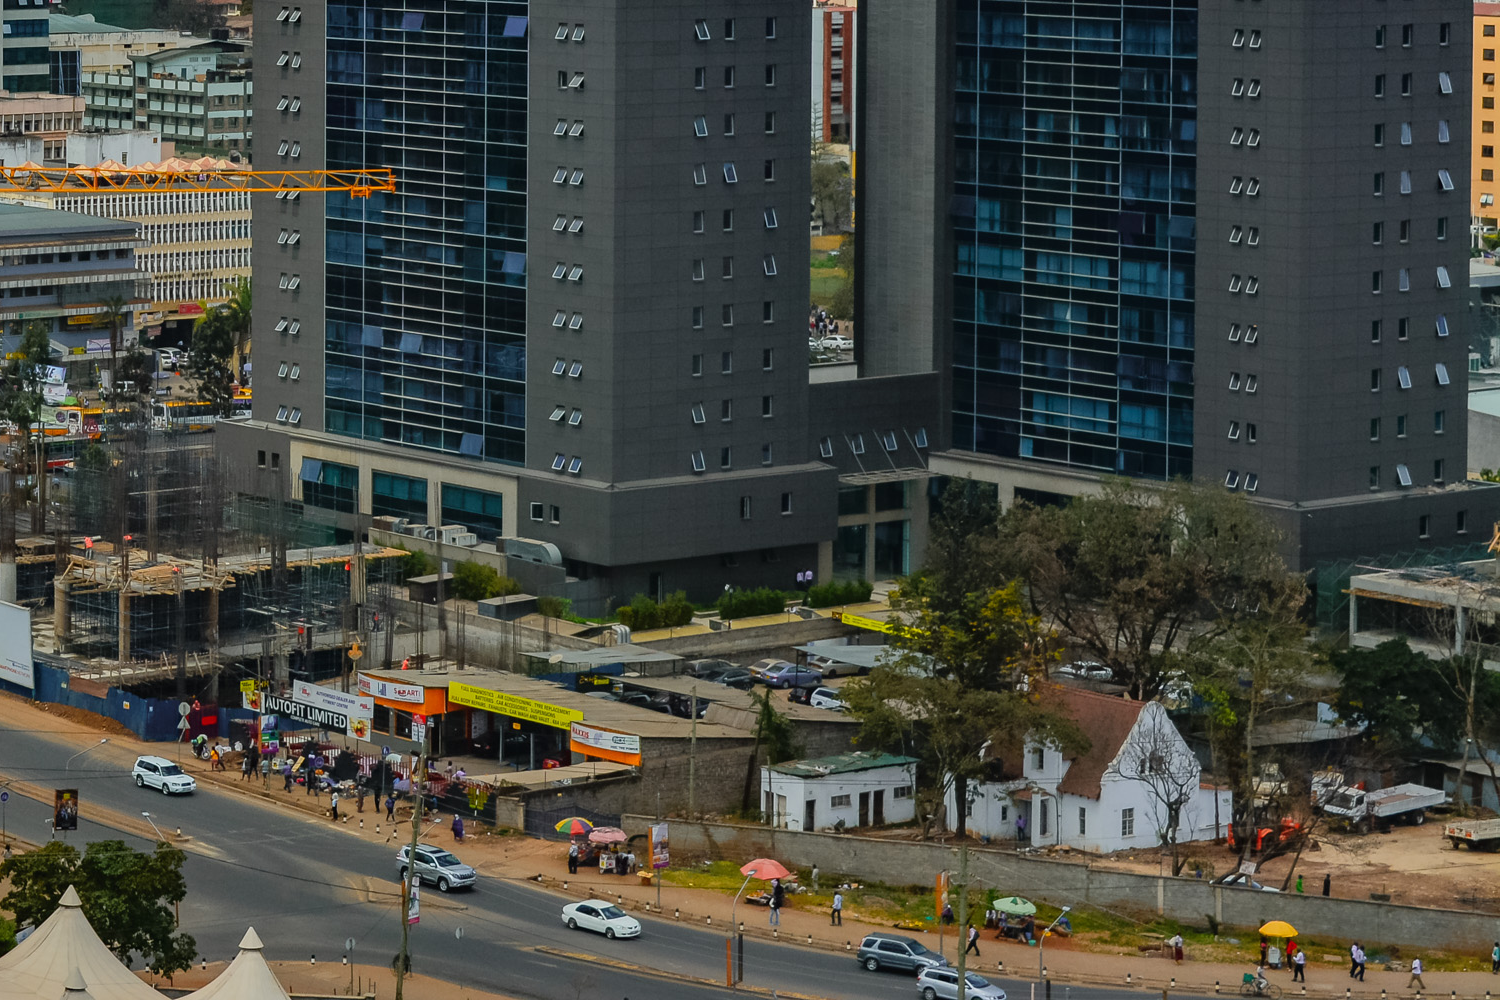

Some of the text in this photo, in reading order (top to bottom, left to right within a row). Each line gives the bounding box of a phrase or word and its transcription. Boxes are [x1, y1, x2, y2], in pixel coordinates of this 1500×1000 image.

[266, 696, 347, 728] AUTOFIT LIMITED
[470, 687, 494, 697] DIAGNOSTICS
[504, 695, 531, 706] CONDITIONING
[544, 704, 571, 715] REPLACEMENT
[471, 700, 486, 708] REPAIRS
[488, 704, 508, 713] EXHAUSTS
[475, 695, 494, 703] BATTERIES
[504, 701, 528, 711] ACCESSORIES
[530, 707, 556, 718] SUSPENSIONS
